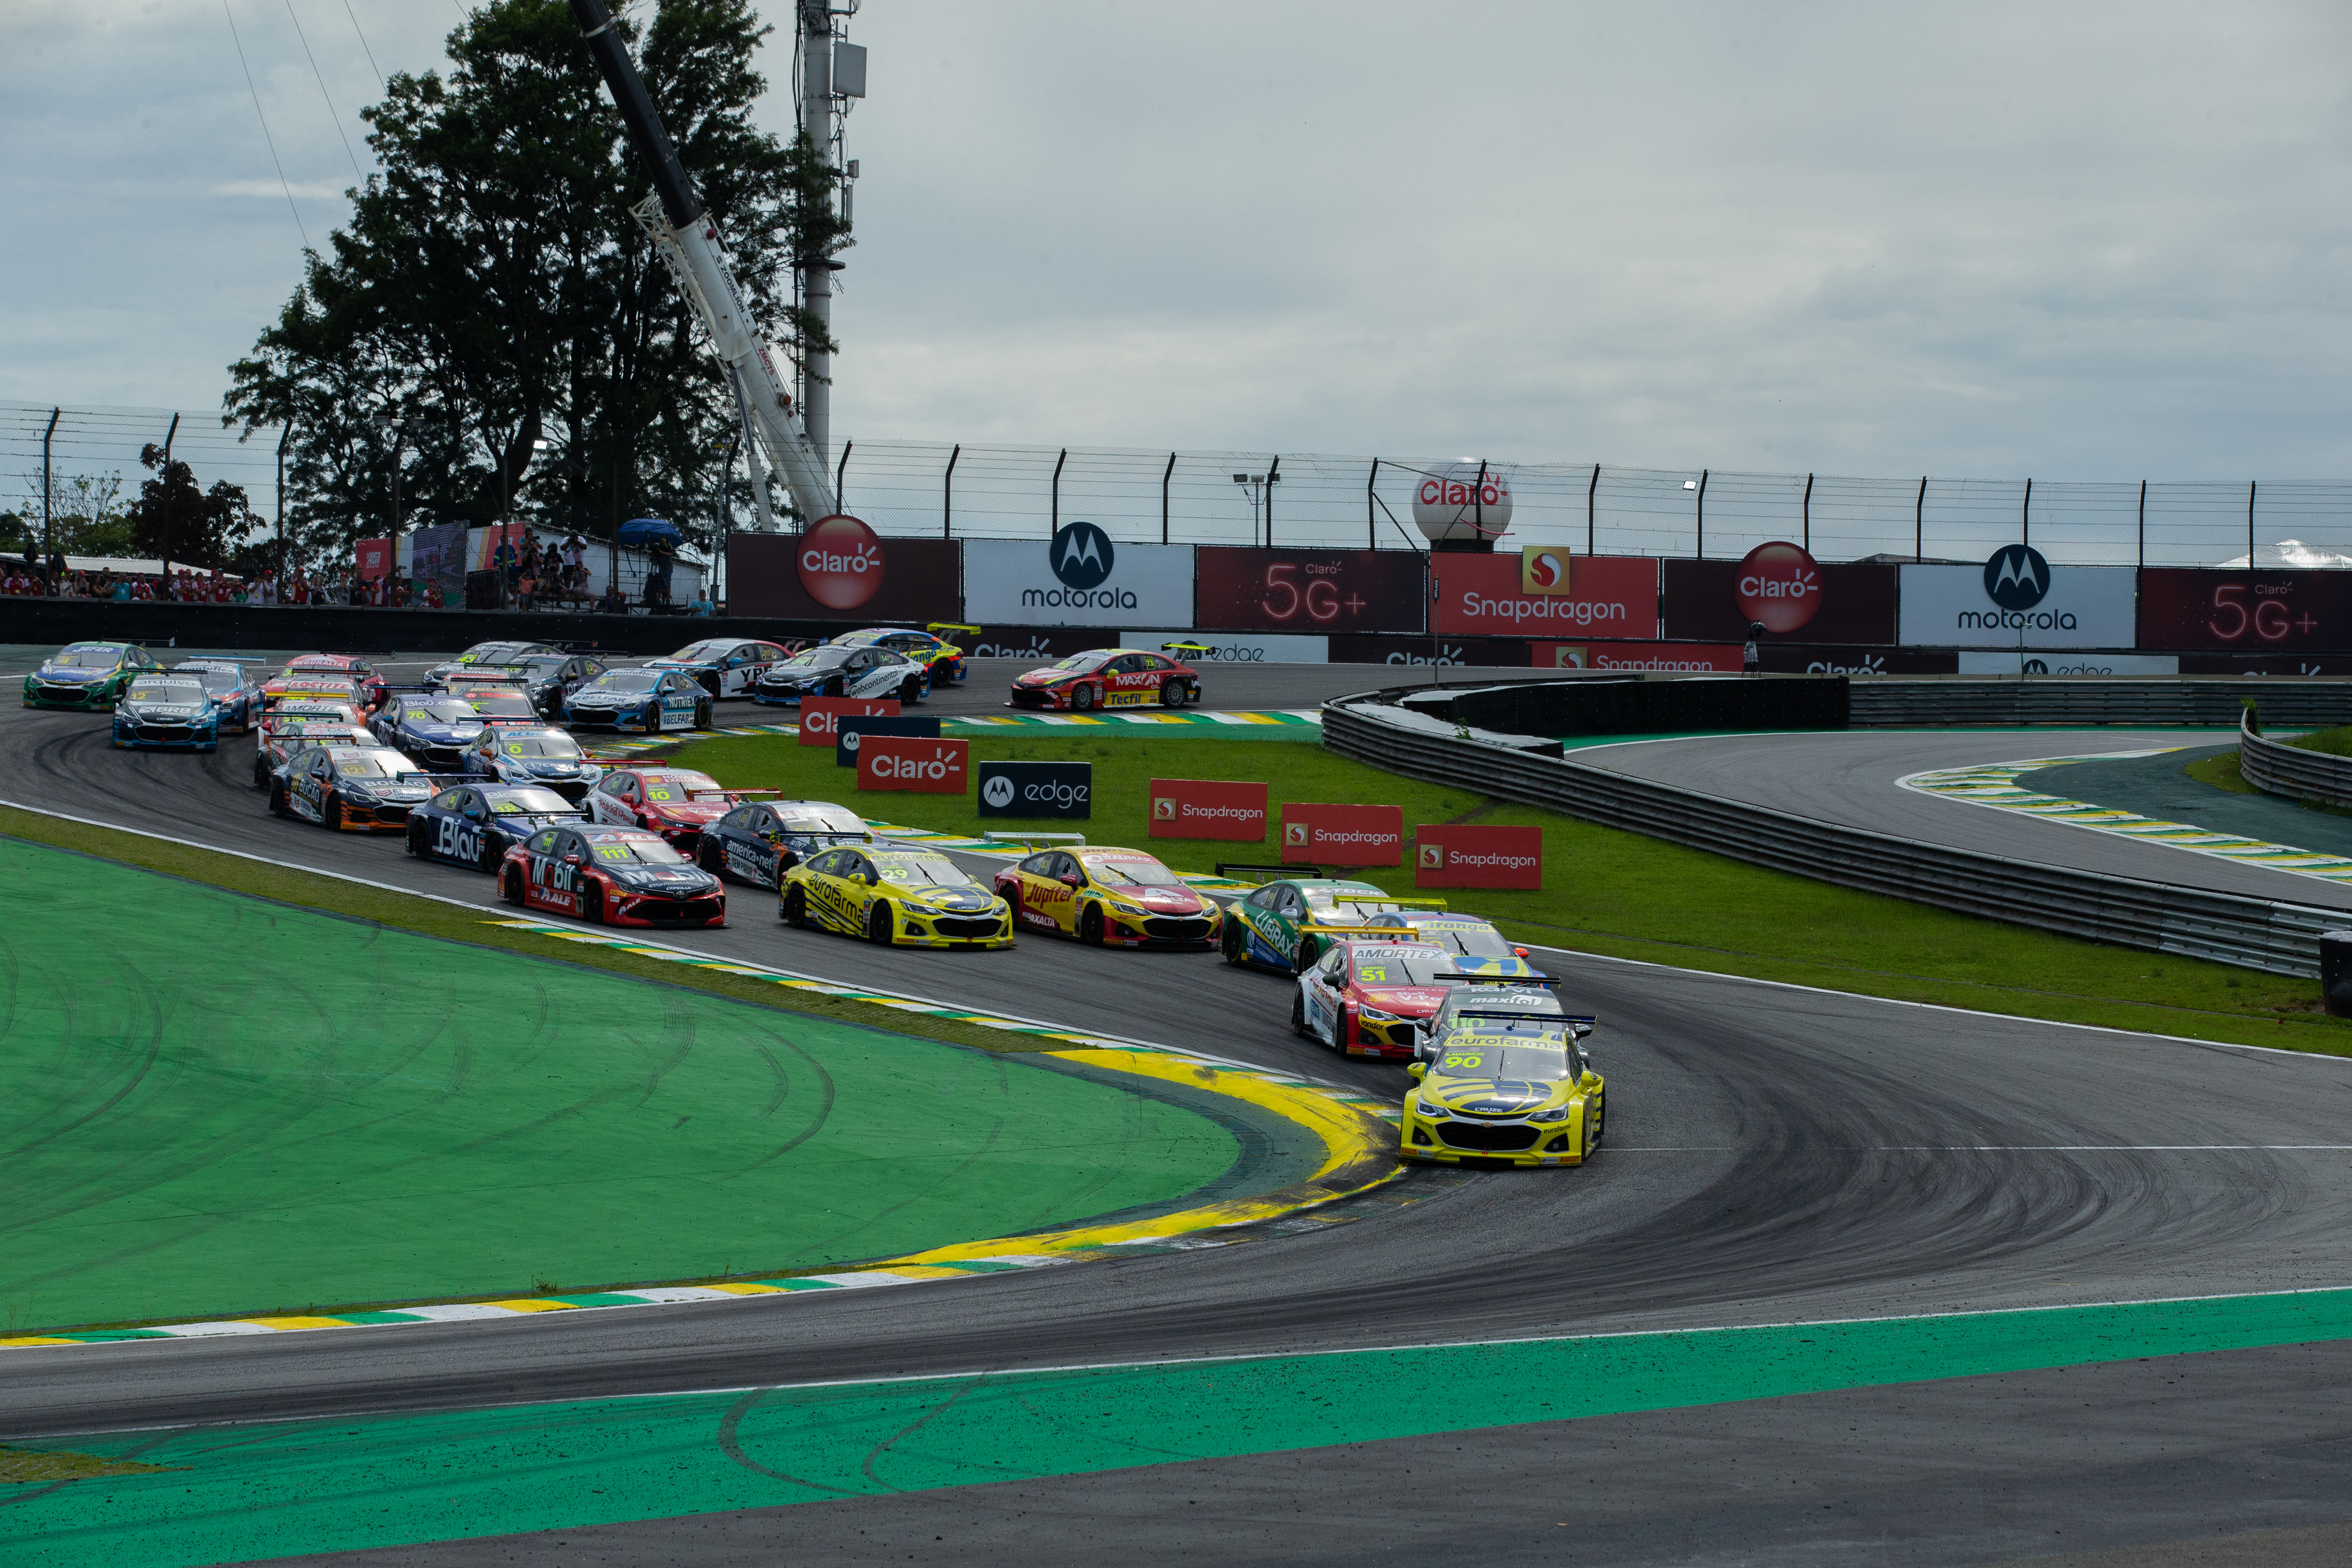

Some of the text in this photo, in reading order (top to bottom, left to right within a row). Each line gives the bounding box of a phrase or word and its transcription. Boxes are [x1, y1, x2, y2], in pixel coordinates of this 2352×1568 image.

[720, 265, 746, 313] ZOOMLION
[758, 346, 775, 376] ZMC75
[1421, 480, 1499, 505] Claro
[803, 550, 867, 573] Claro
[1306, 563, 1338, 574] Claro
[1263, 564, 1366, 621] 5G+
[1740, 577, 1802, 597] Claro
[2254, 583, 2286, 594] Claro
[1023, 588, 1137, 609] motorola
[1463, 592, 1625, 626] Snapdragon
[2209, 585, 2318, 639] 5G+
[1958, 608, 2076, 630] motorola
[975, 643, 1037, 658] Claro
[1211, 643, 1264, 662] edge
[1387, 652, 1450, 666] Claro
[1596, 655, 1712, 670] Snapdragon
[1111, 693, 1143, 704] Tecfil
[806, 711, 838, 733] Cla
[509, 745, 522, 754] 0
[343, 766, 367, 775] 121
[871, 755, 946, 779] Claro
[449, 796, 456, 804] 18
[649, 791, 670, 800] 10
[1025, 780, 1088, 808] edge
[1182, 804, 1263, 819] Snapdragon
[544, 837, 552, 847] 111
[1315, 829, 1398, 845] Snapdragon
[600, 849, 629, 859] 111
[872, 852, 947, 861] eurofarma
[1450, 851, 1536, 868] Snapdragon
[827, 856, 837, 867] 29
[1041, 860, 1050, 868] 83
[532, 856, 576, 891] Mobil
[740, 862, 753, 877] PARAR
[881, 869, 908, 879] 29
[623, 871, 715, 884] Mobil
[1097, 873, 1125, 882] 83
[550, 893, 571, 907] ALE
[808, 873, 863, 924] eurofarma
[1267, 892, 1275, 901] 19
[627, 898, 641, 910] ALE
[902, 912, 927, 922] eurofarma
[1029, 912, 1055, 928] AXALTA
[1418, 921, 1489, 931] piranga
[1255, 910, 1294, 959] LUBRAX
[1255, 944, 1275, 963] SEGURADORA
[1354, 949, 1443, 959] AMORTEX
[1361, 970, 1386, 981] 51
[1361, 1019, 1385, 1031] vonder
[1448, 1018, 1486, 1029] 110
[1450, 1036, 1562, 1050] eurofarma
[1445, 1056, 1481, 1069] 90
[1544, 1123, 1571, 1134] eurofarma
